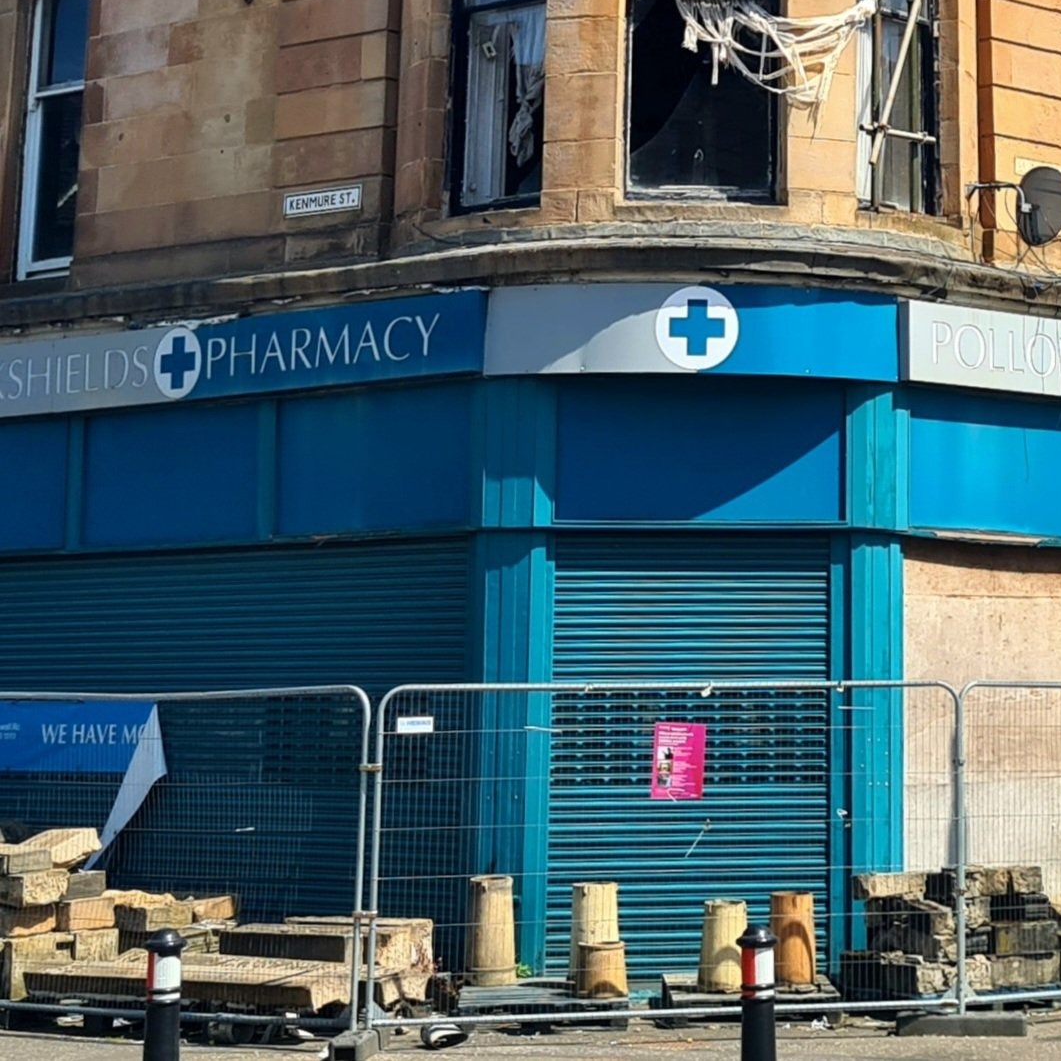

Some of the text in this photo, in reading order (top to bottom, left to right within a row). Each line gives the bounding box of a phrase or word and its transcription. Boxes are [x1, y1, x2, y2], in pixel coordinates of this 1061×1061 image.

[289, 191, 355, 211] KENMURE ST.
[0, 313, 440, 400] SHIELDS PHARMACY
[41, 724, 67, 744] WE
[72, 724, 117, 745] HAVE
